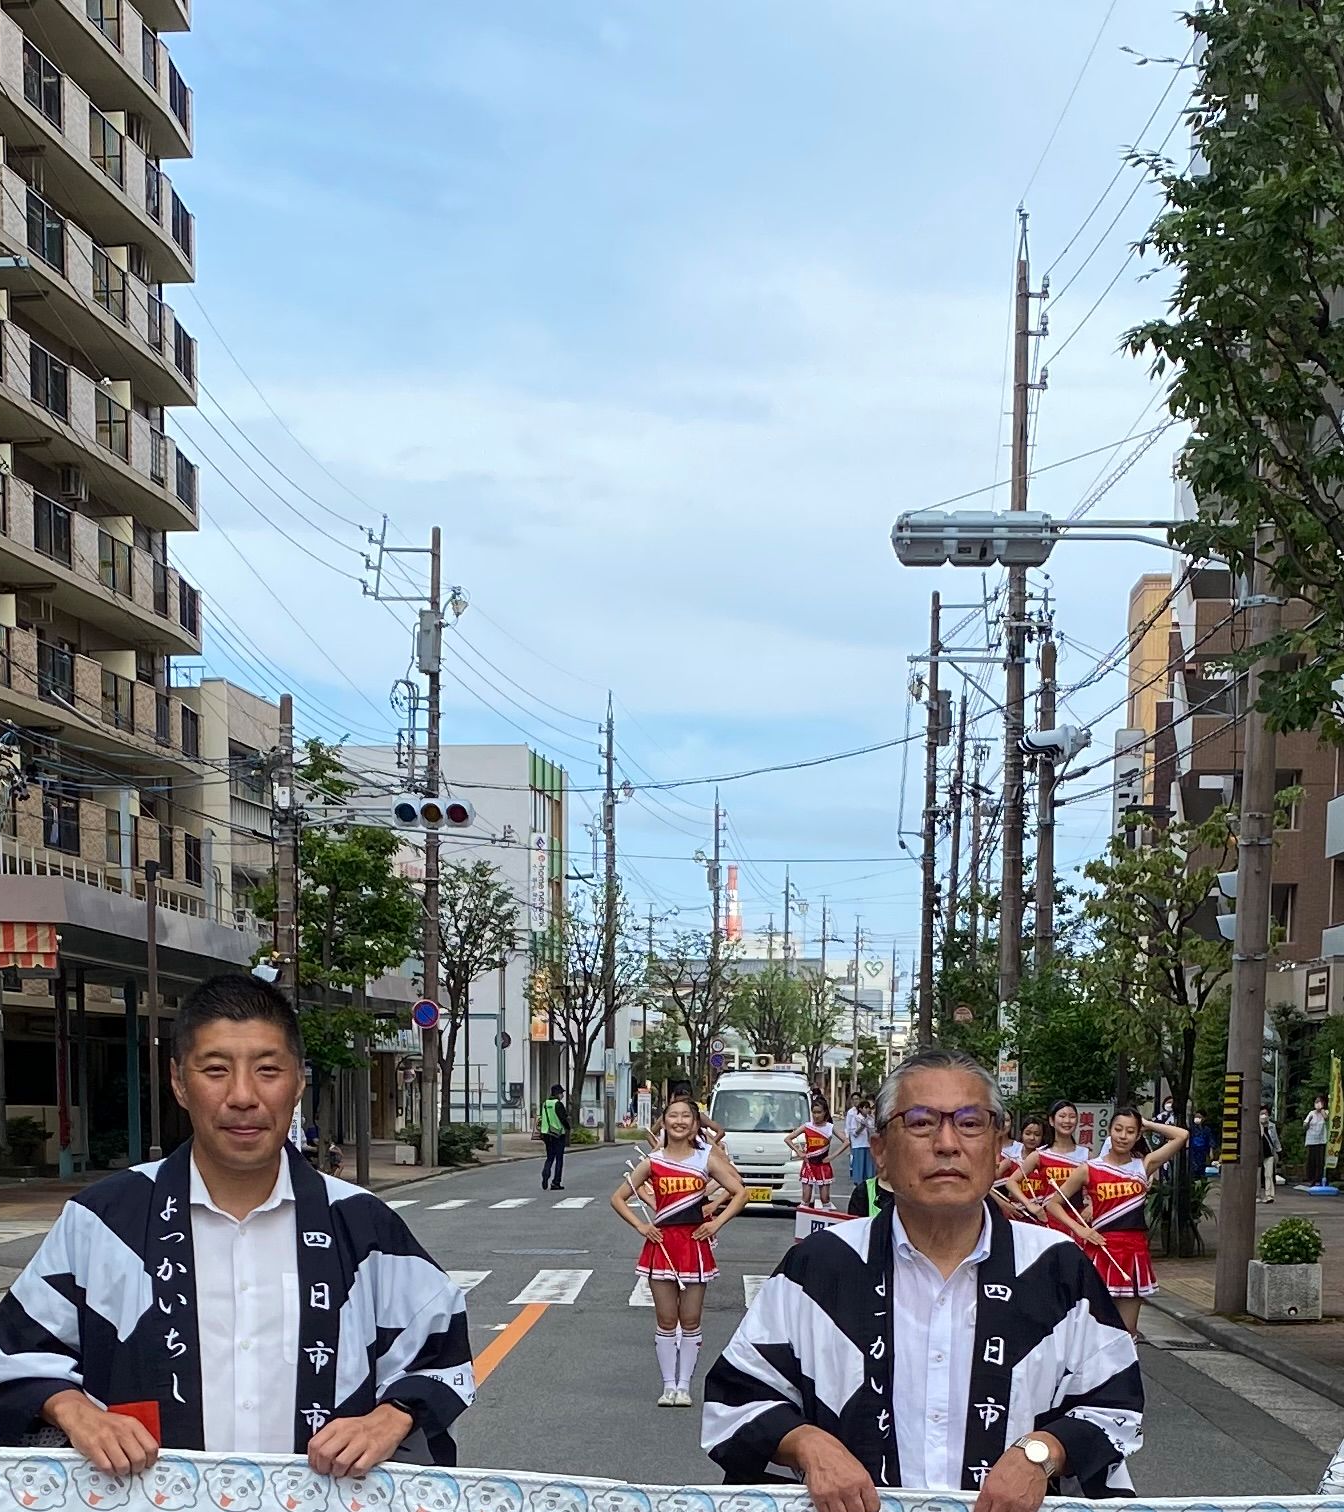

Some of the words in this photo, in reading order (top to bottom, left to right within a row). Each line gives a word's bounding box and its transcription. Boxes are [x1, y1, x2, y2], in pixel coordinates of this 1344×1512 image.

[1078, 1111, 1094, 1152] 美顔
[659, 1176, 704, 1195] SHIKO
[1045, 1166, 1073, 1181] SHI
[1096, 1181, 1142, 1201] SHIKO
[156, 1195, 188, 1404] よっかいちし
[299, 1231, 335, 1434] 四日市市
